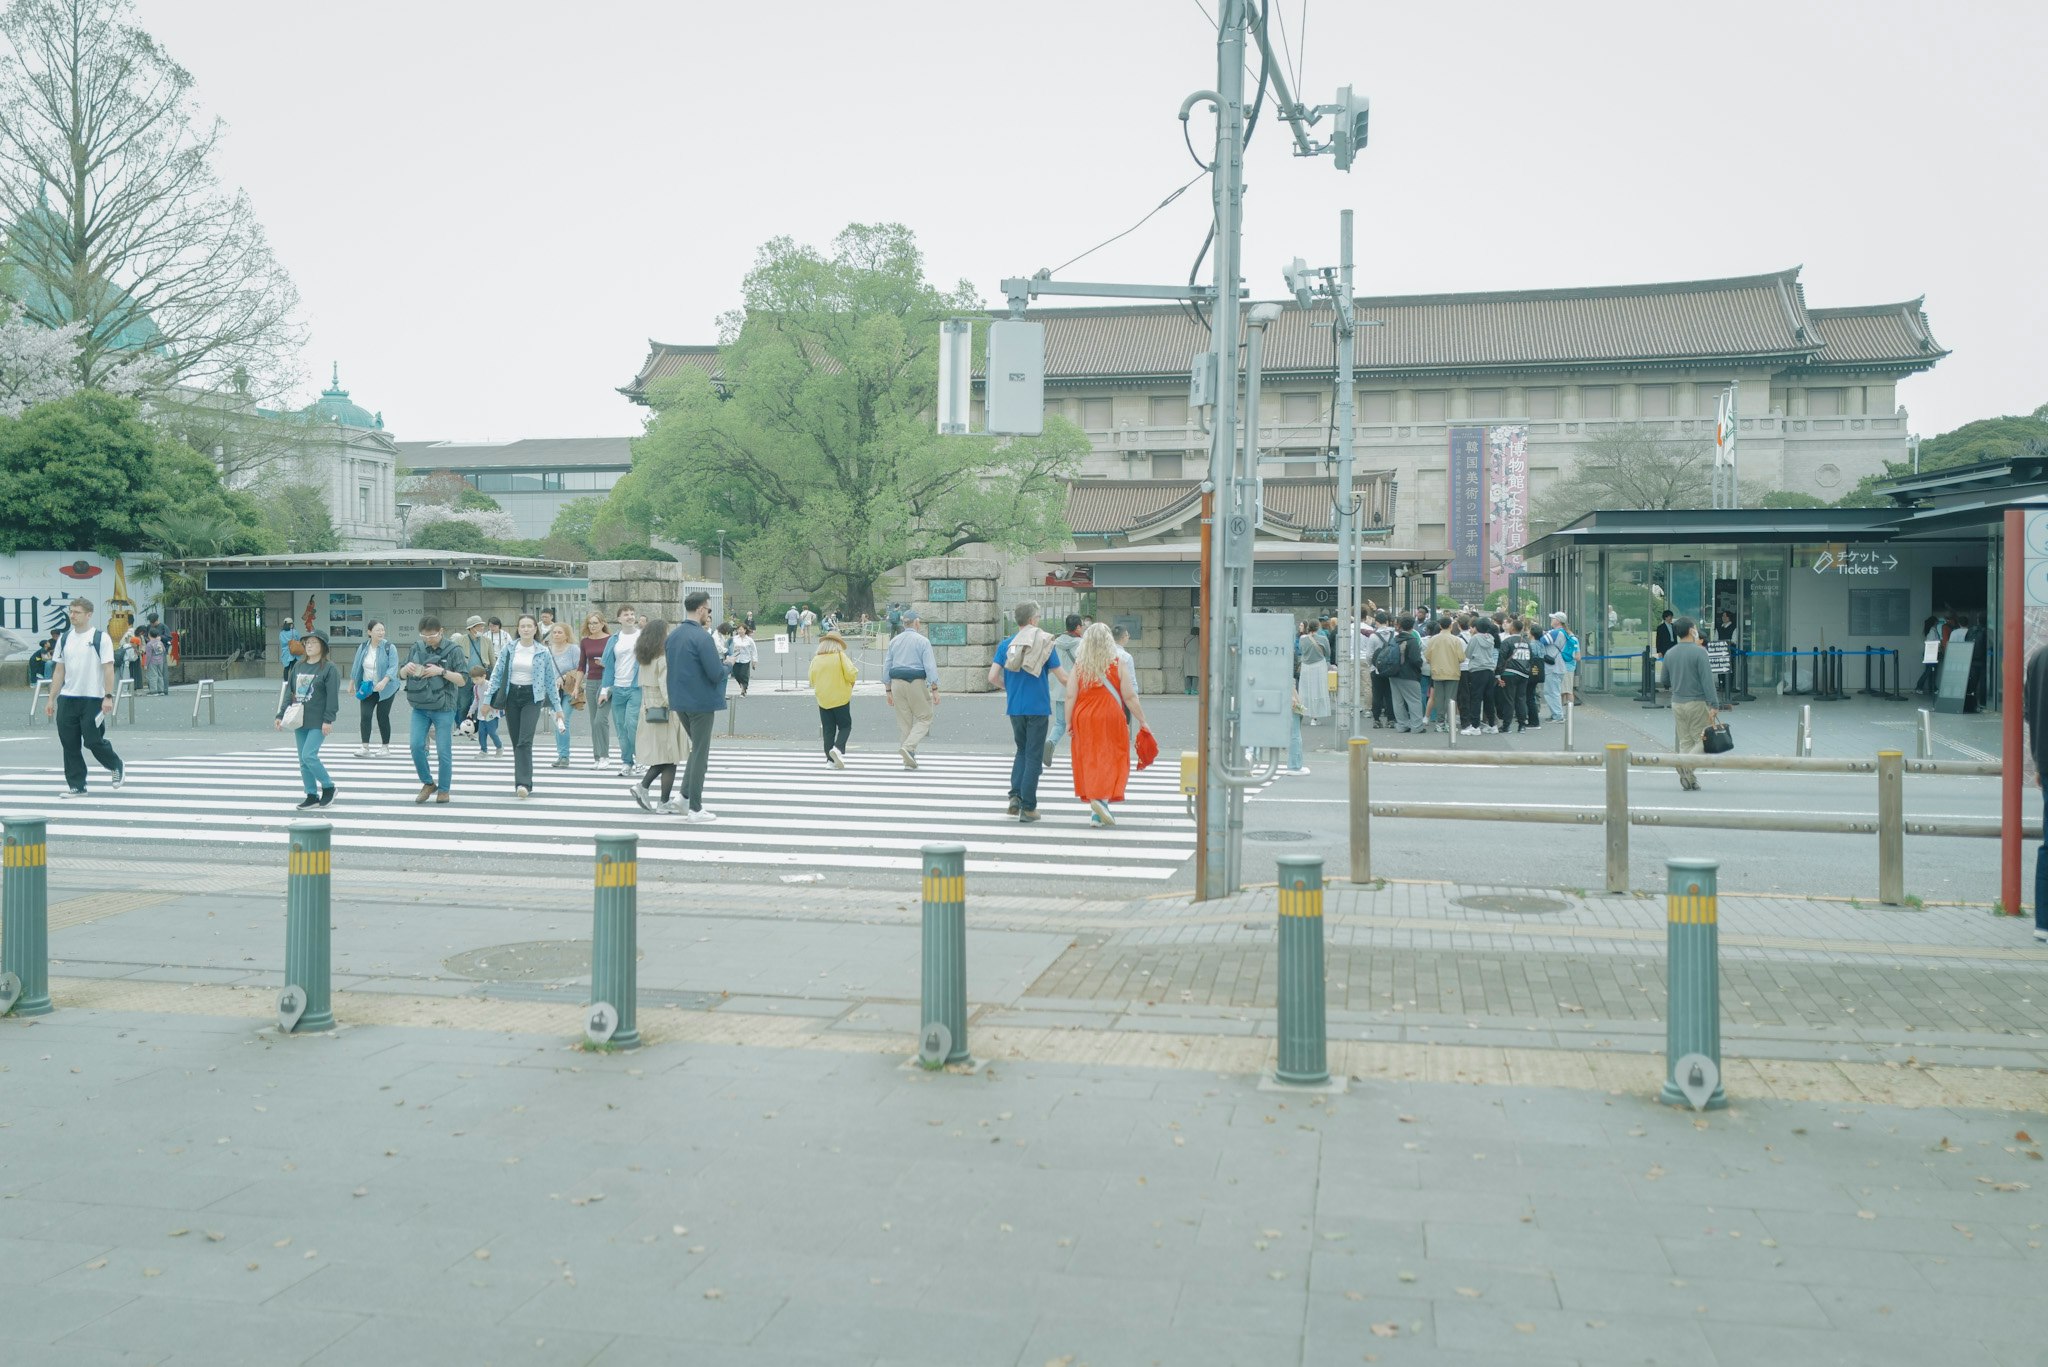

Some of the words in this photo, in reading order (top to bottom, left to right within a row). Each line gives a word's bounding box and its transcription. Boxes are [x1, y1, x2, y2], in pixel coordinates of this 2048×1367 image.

[1465, 441, 1479, 557] 韓国美術の玉手箱
[1837, 551, 1879, 562] チケット
[1837, 564, 1879, 575] Tickets
[1751, 570, 1779, 581] 入口
[1248, 646, 1286, 656] 660-71
